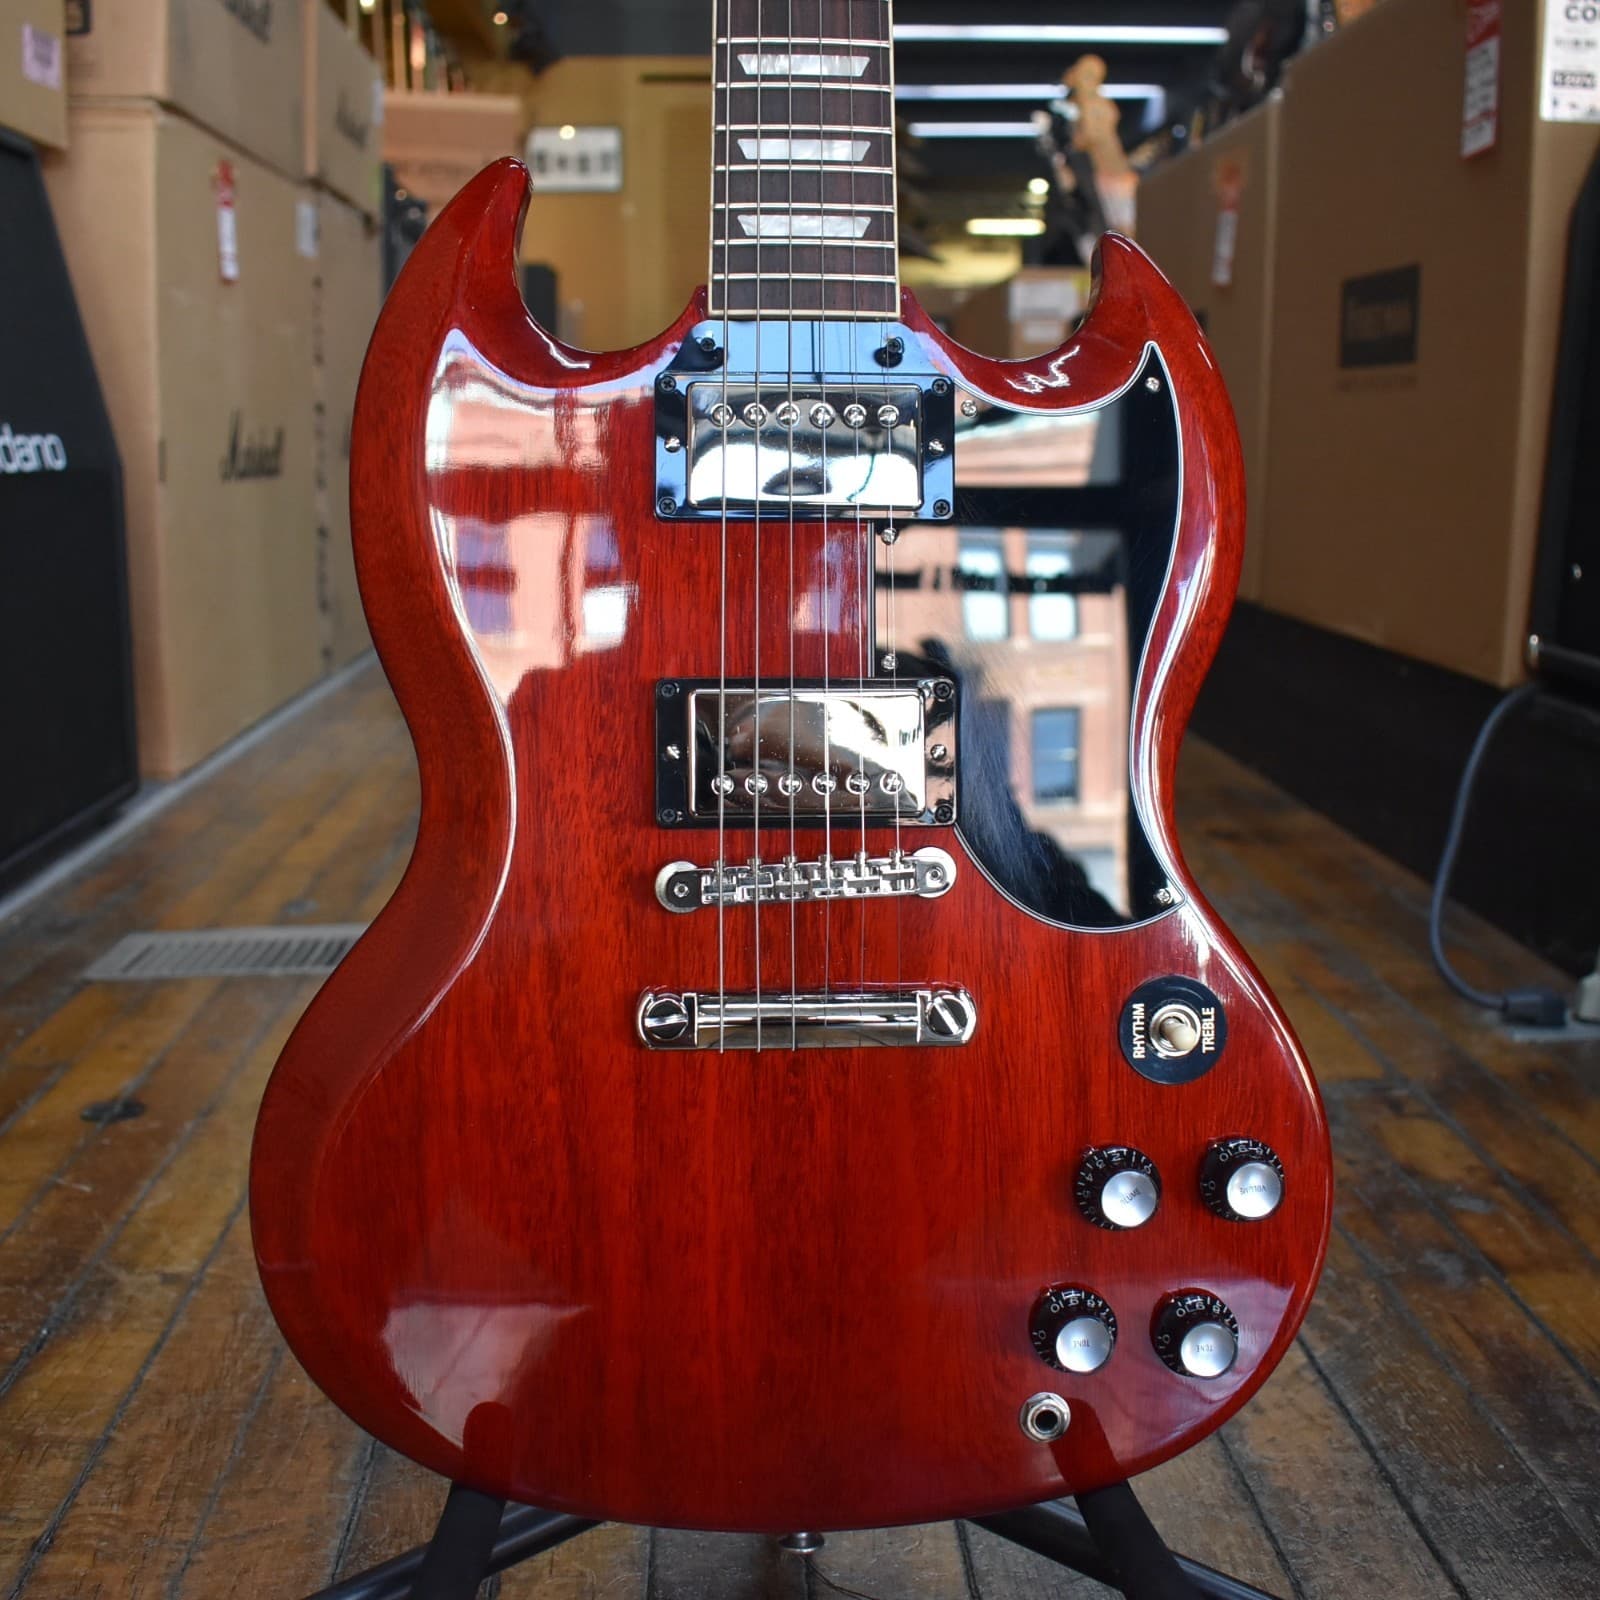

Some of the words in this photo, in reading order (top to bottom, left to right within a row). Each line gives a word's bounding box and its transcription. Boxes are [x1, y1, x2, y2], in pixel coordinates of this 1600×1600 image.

[1564, 5, 1600, 23] CO
[1132, 1003, 1146, 1059] RHYTHM
[1201, 1007, 1215, 1054] TREBLE
